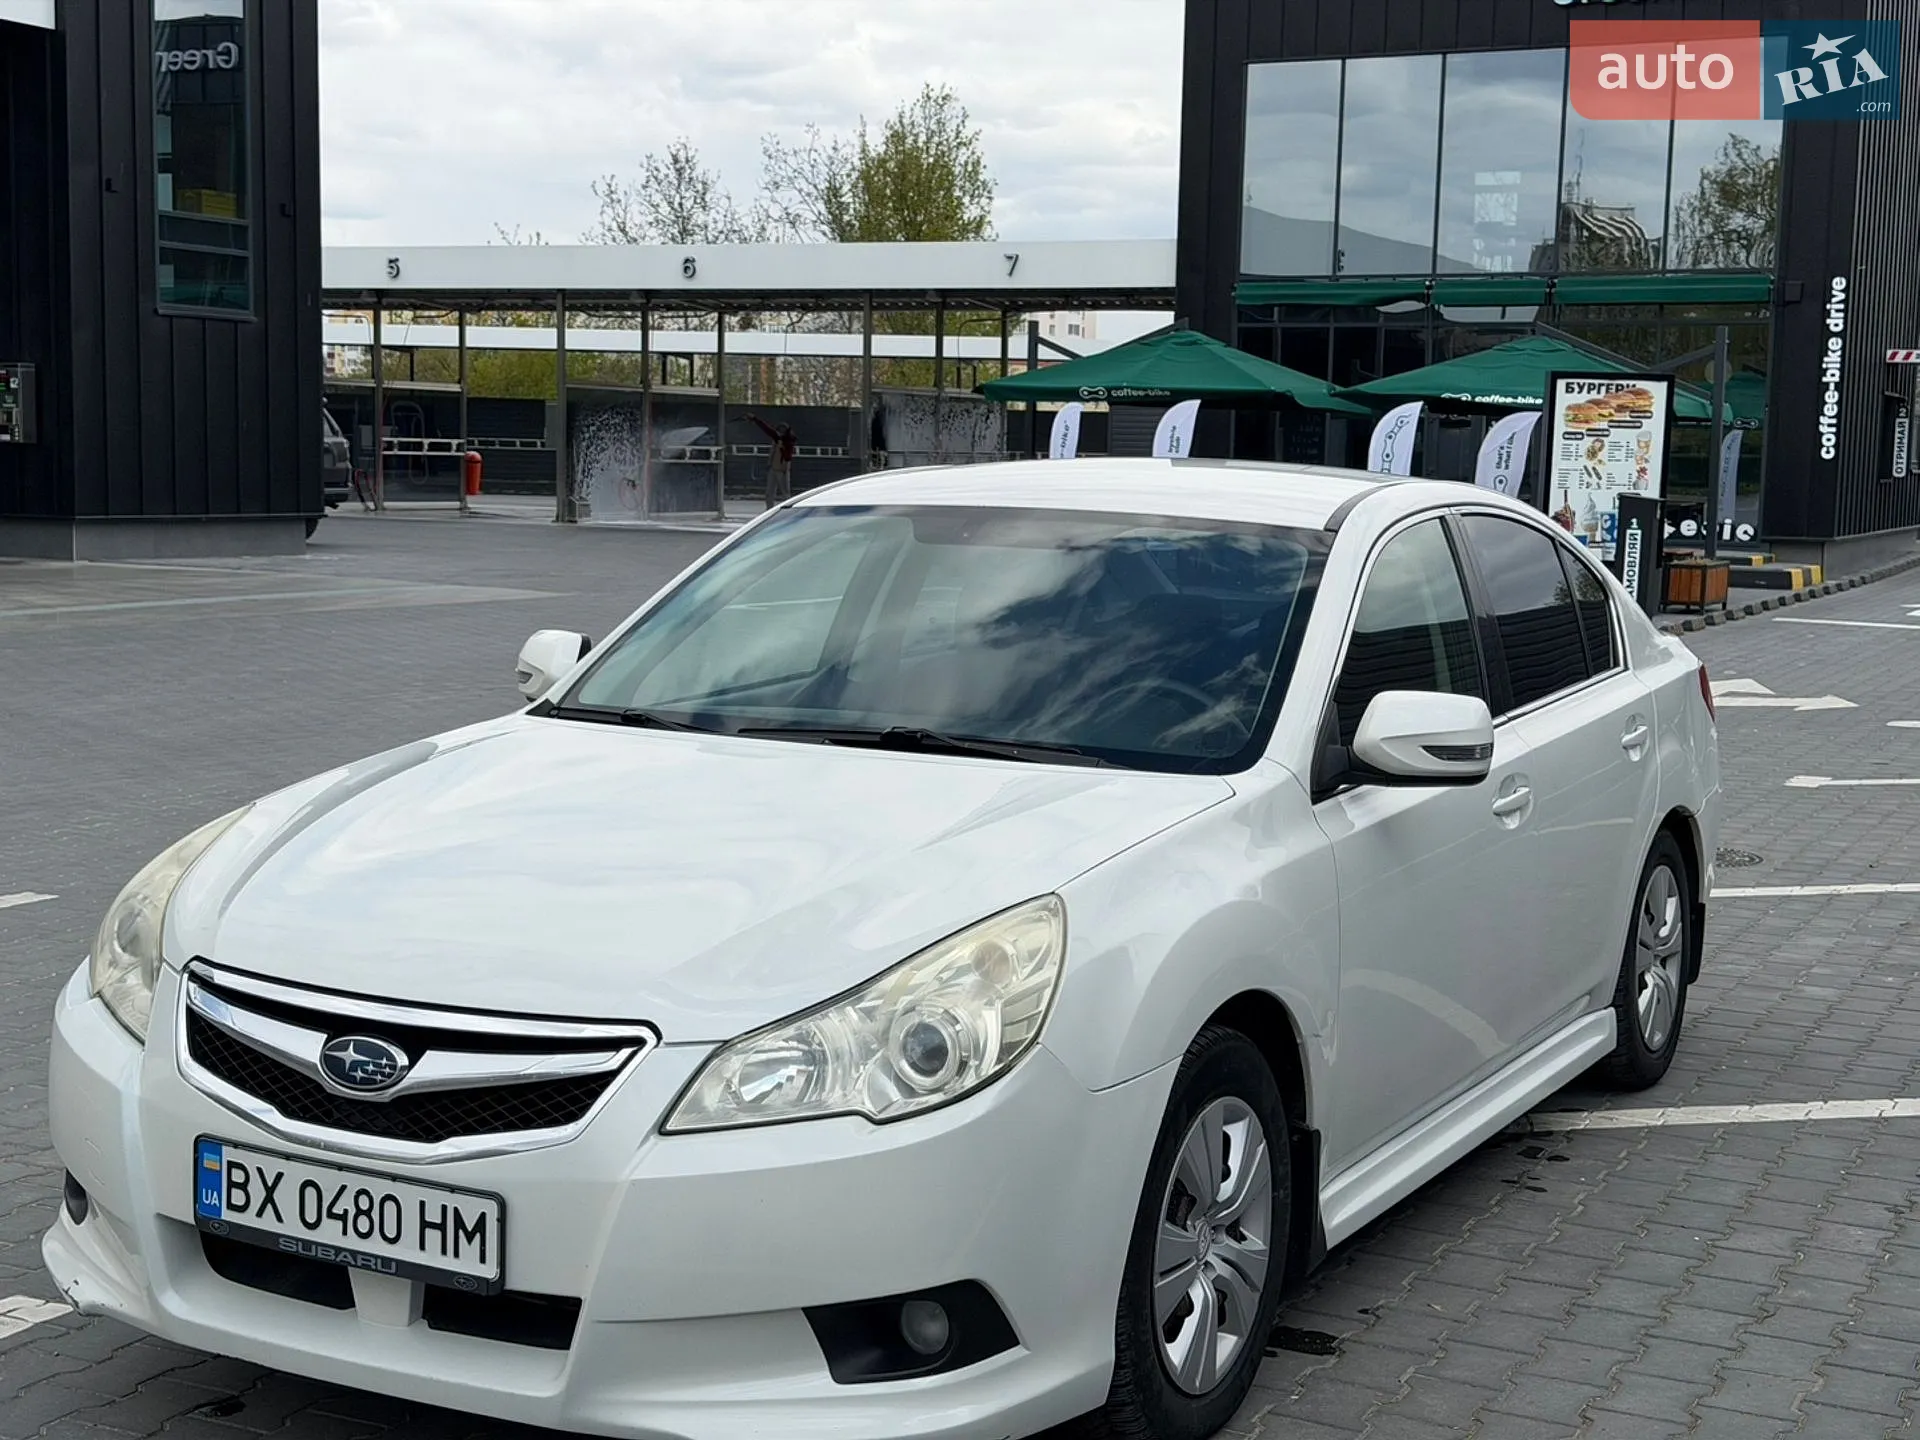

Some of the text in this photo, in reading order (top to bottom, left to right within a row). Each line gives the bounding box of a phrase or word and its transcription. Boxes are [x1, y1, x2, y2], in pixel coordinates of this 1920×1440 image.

[387, 257, 401, 279] 5
[683, 256, 697, 279] 6
[1004, 254, 1019, 277] 7
[1818, 276, 1847, 460] coffee-bike drive
[1475, 395, 1542, 404] coffee-bike
[1625, 532, 1640, 600] АМОВЛЯЙ
[202, 1188, 220, 1207] UA
[226, 1160, 487, 1265] BX 0480 HM
[278, 1237, 398, 1273] SUBARU
